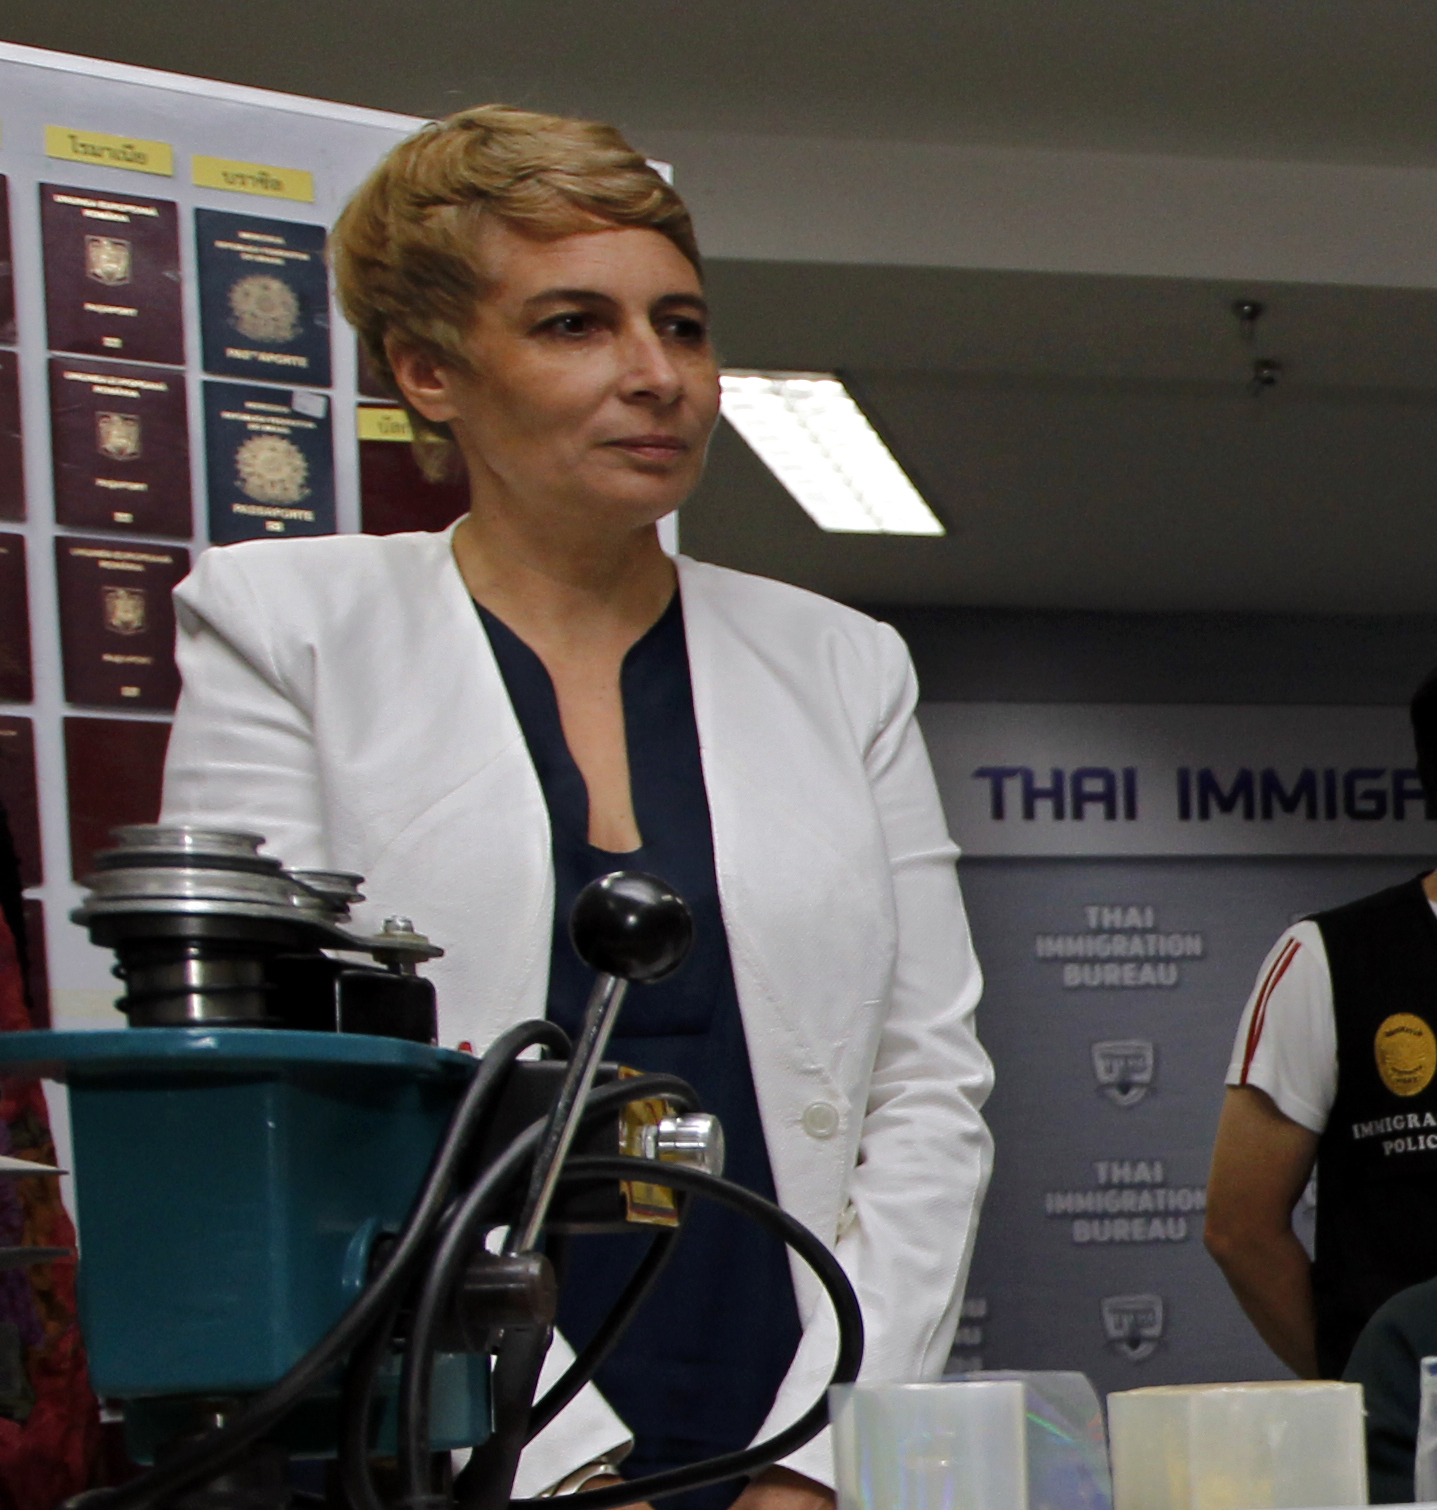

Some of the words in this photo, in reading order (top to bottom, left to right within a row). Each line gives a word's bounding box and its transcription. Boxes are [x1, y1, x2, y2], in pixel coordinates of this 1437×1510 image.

[971, 766, 1137, 820] THAI
[1085, 904, 1155, 929] THAI
[1035, 932, 1203, 958] IMMIGRATION
[1062, 961, 1178, 988] BUREAU
[1093, 1160, 1164, 1185] THAI
[1072, 1216, 1188, 1243] BUREAU
